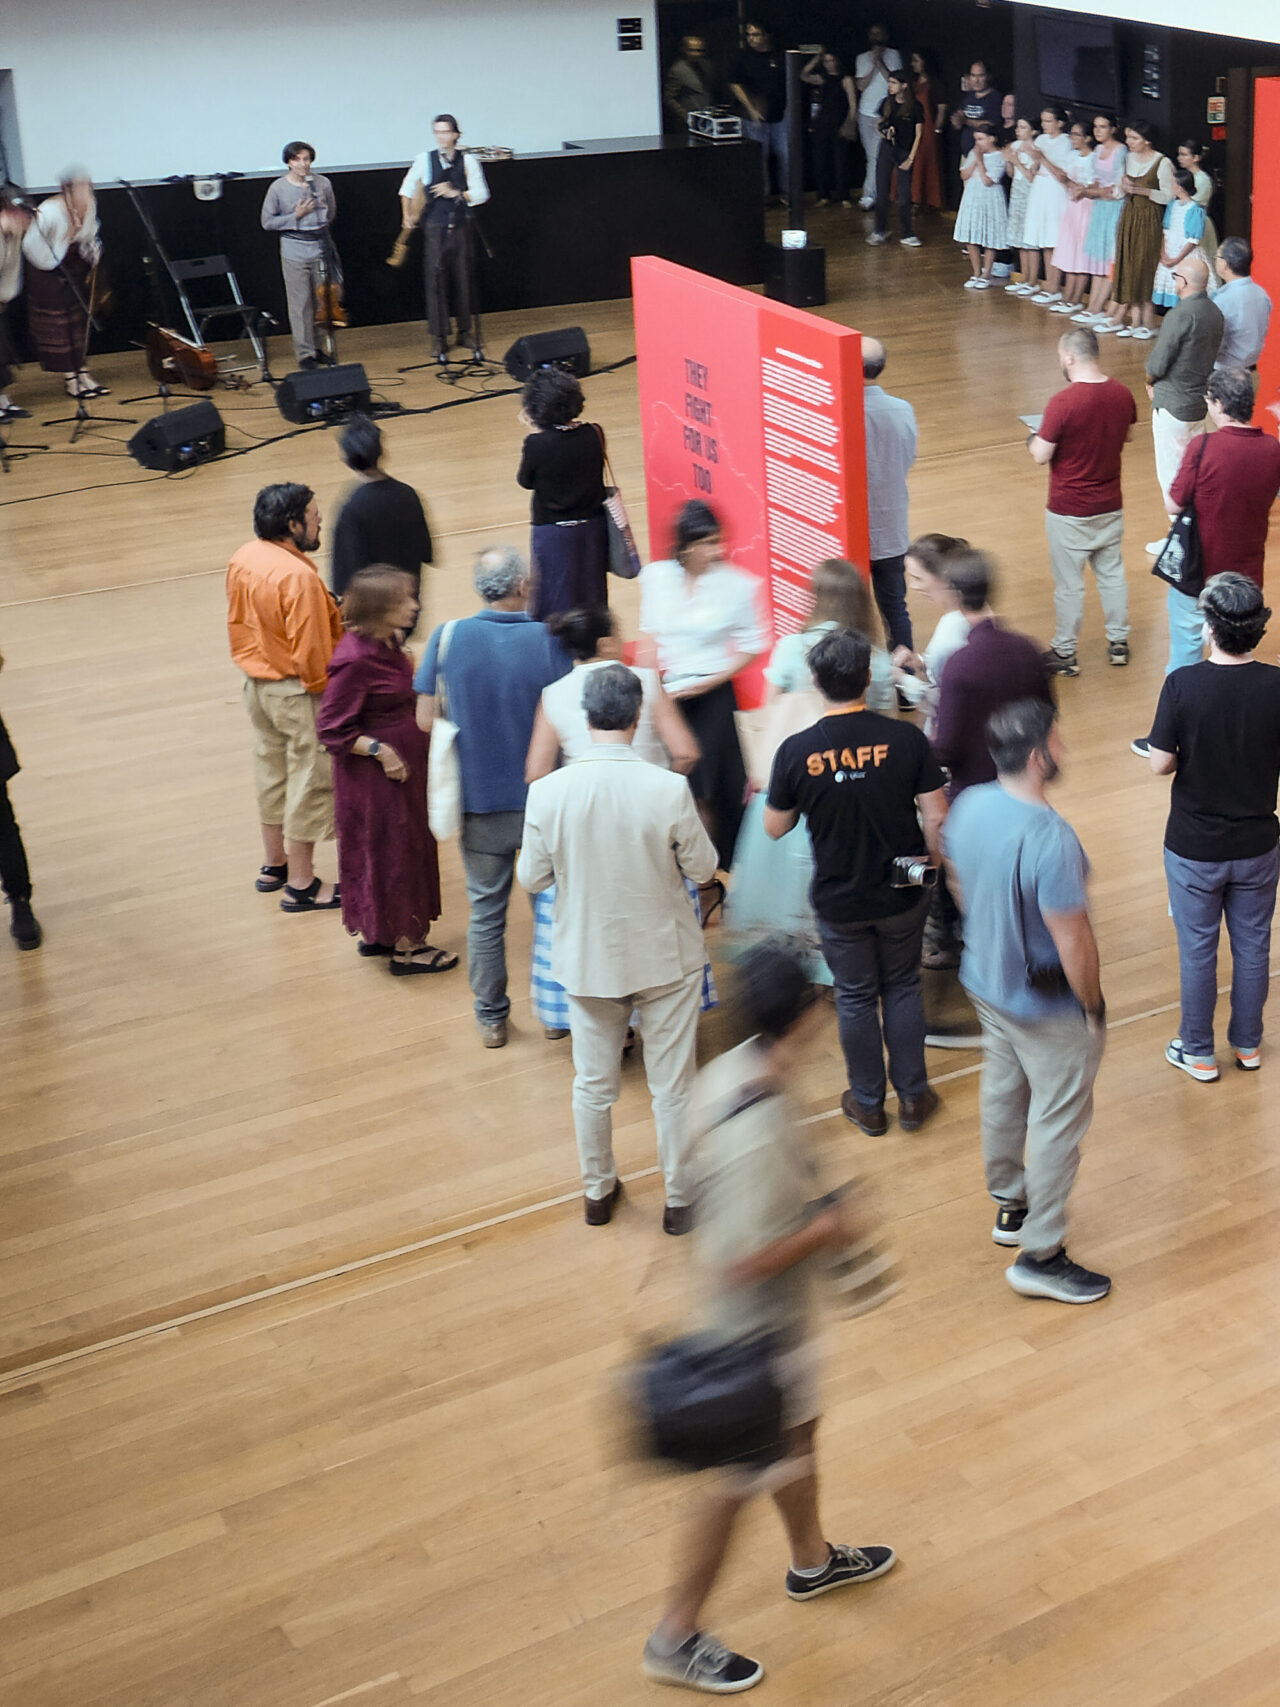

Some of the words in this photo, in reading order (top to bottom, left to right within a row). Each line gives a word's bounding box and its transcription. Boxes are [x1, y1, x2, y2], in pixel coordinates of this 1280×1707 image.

[685, 358, 708, 391] THEY
[685, 392, 712, 428] FIGHT
[683, 425, 702, 456] FOR
[704, 435, 719, 463] US
[693, 463, 712, 494] TOO
[806, 744, 889, 776] STAFF
